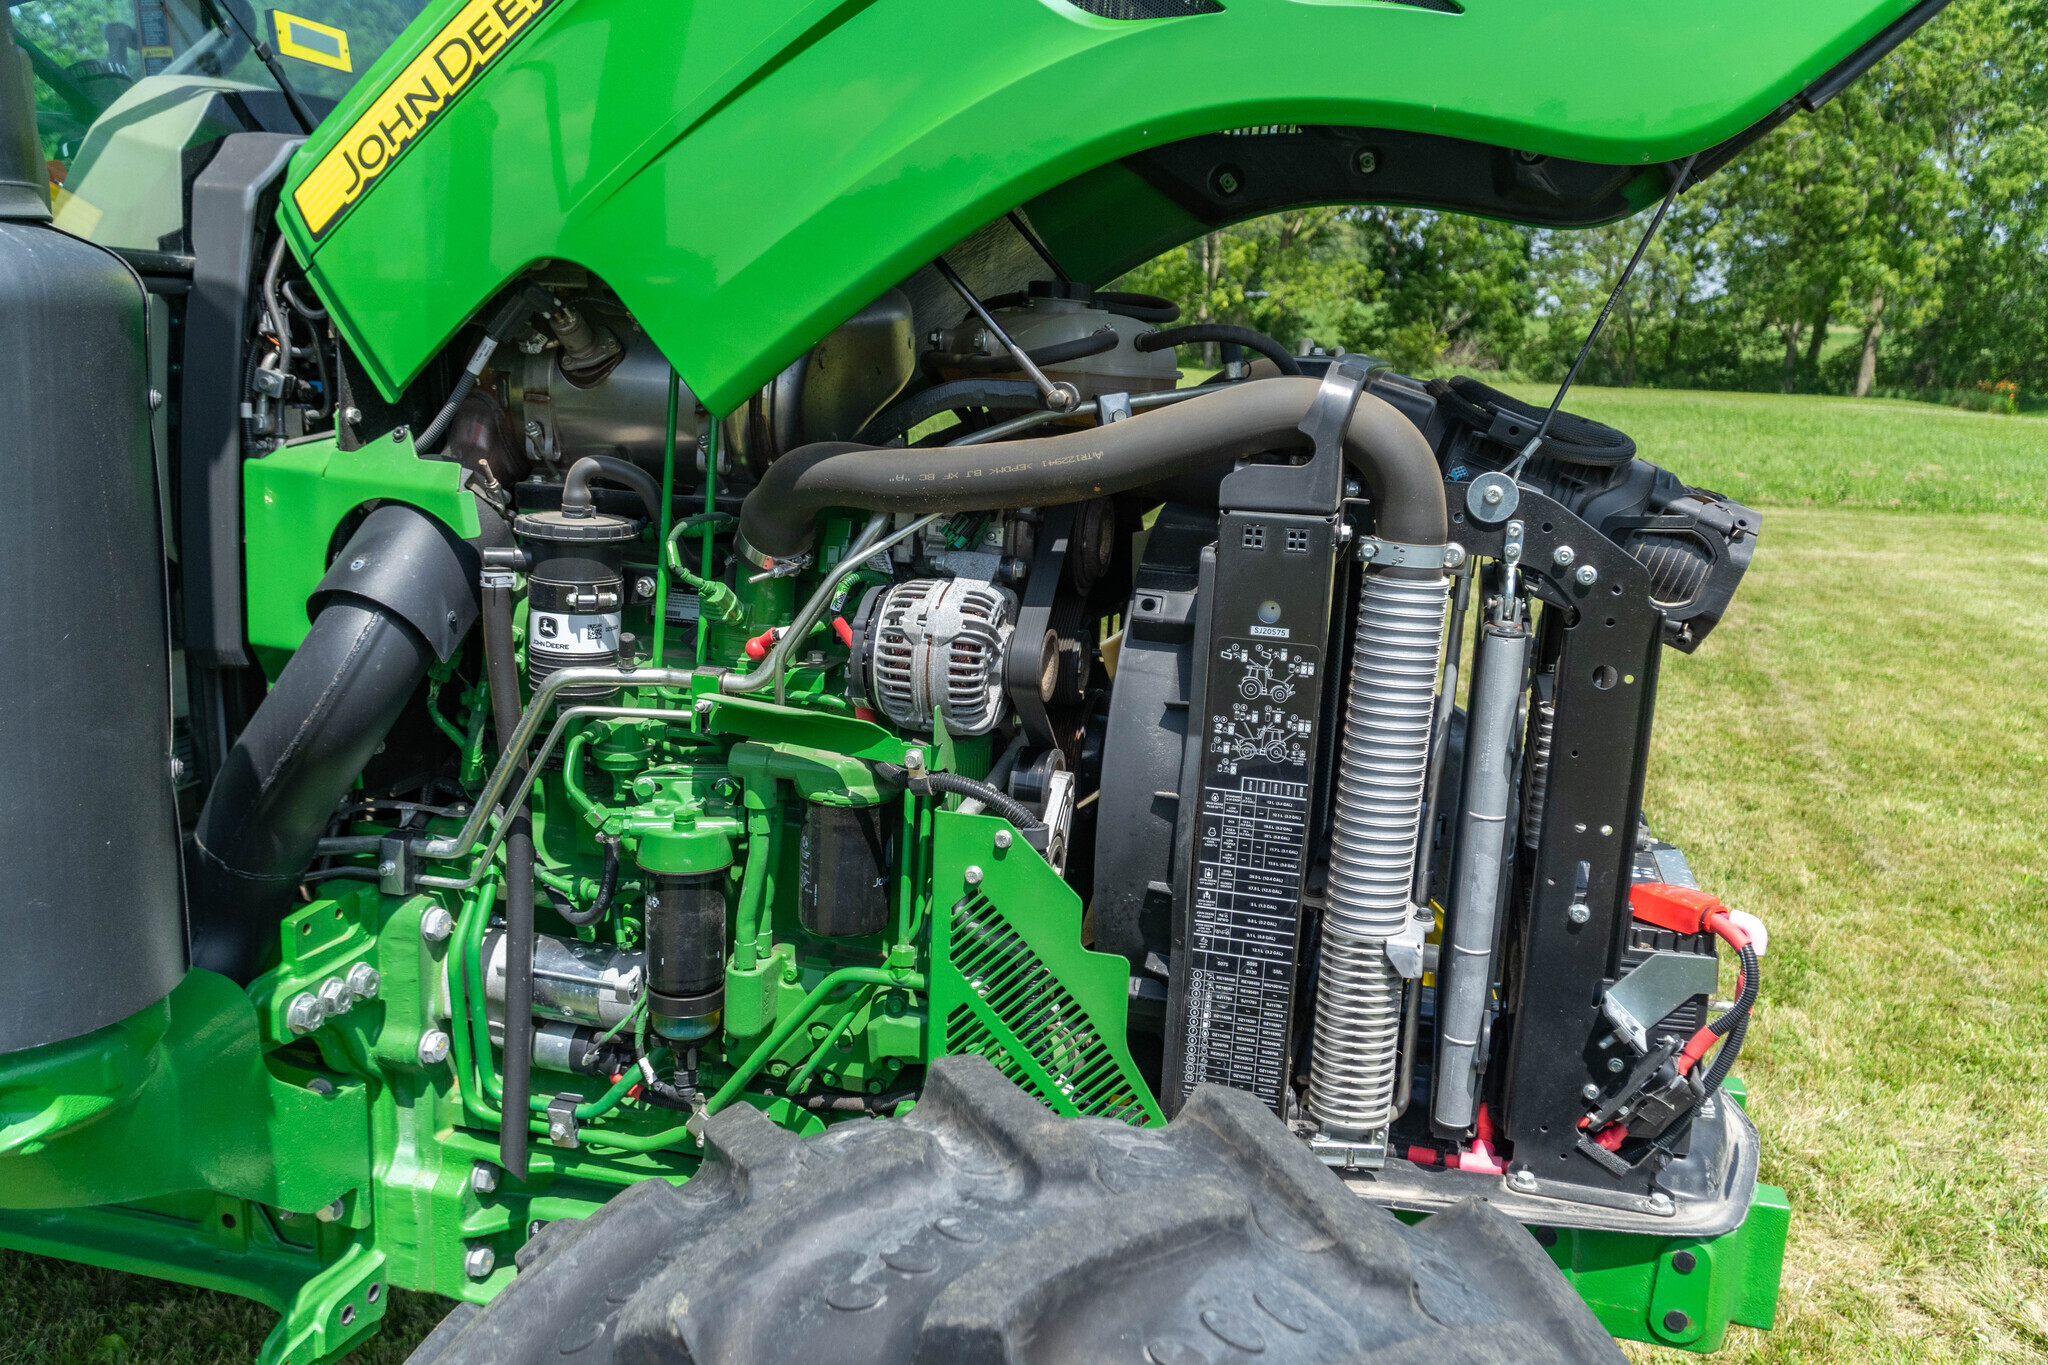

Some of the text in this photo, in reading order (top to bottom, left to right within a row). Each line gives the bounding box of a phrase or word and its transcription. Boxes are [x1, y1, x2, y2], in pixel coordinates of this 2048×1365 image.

[341, 75, 441, 195] JOHN
[919, 472, 935, 481] BC
[966, 469, 982, 478] BJ
[1254, 627, 1286, 636] SJ20575
[533, 639, 569, 650] JOHN DEERE
